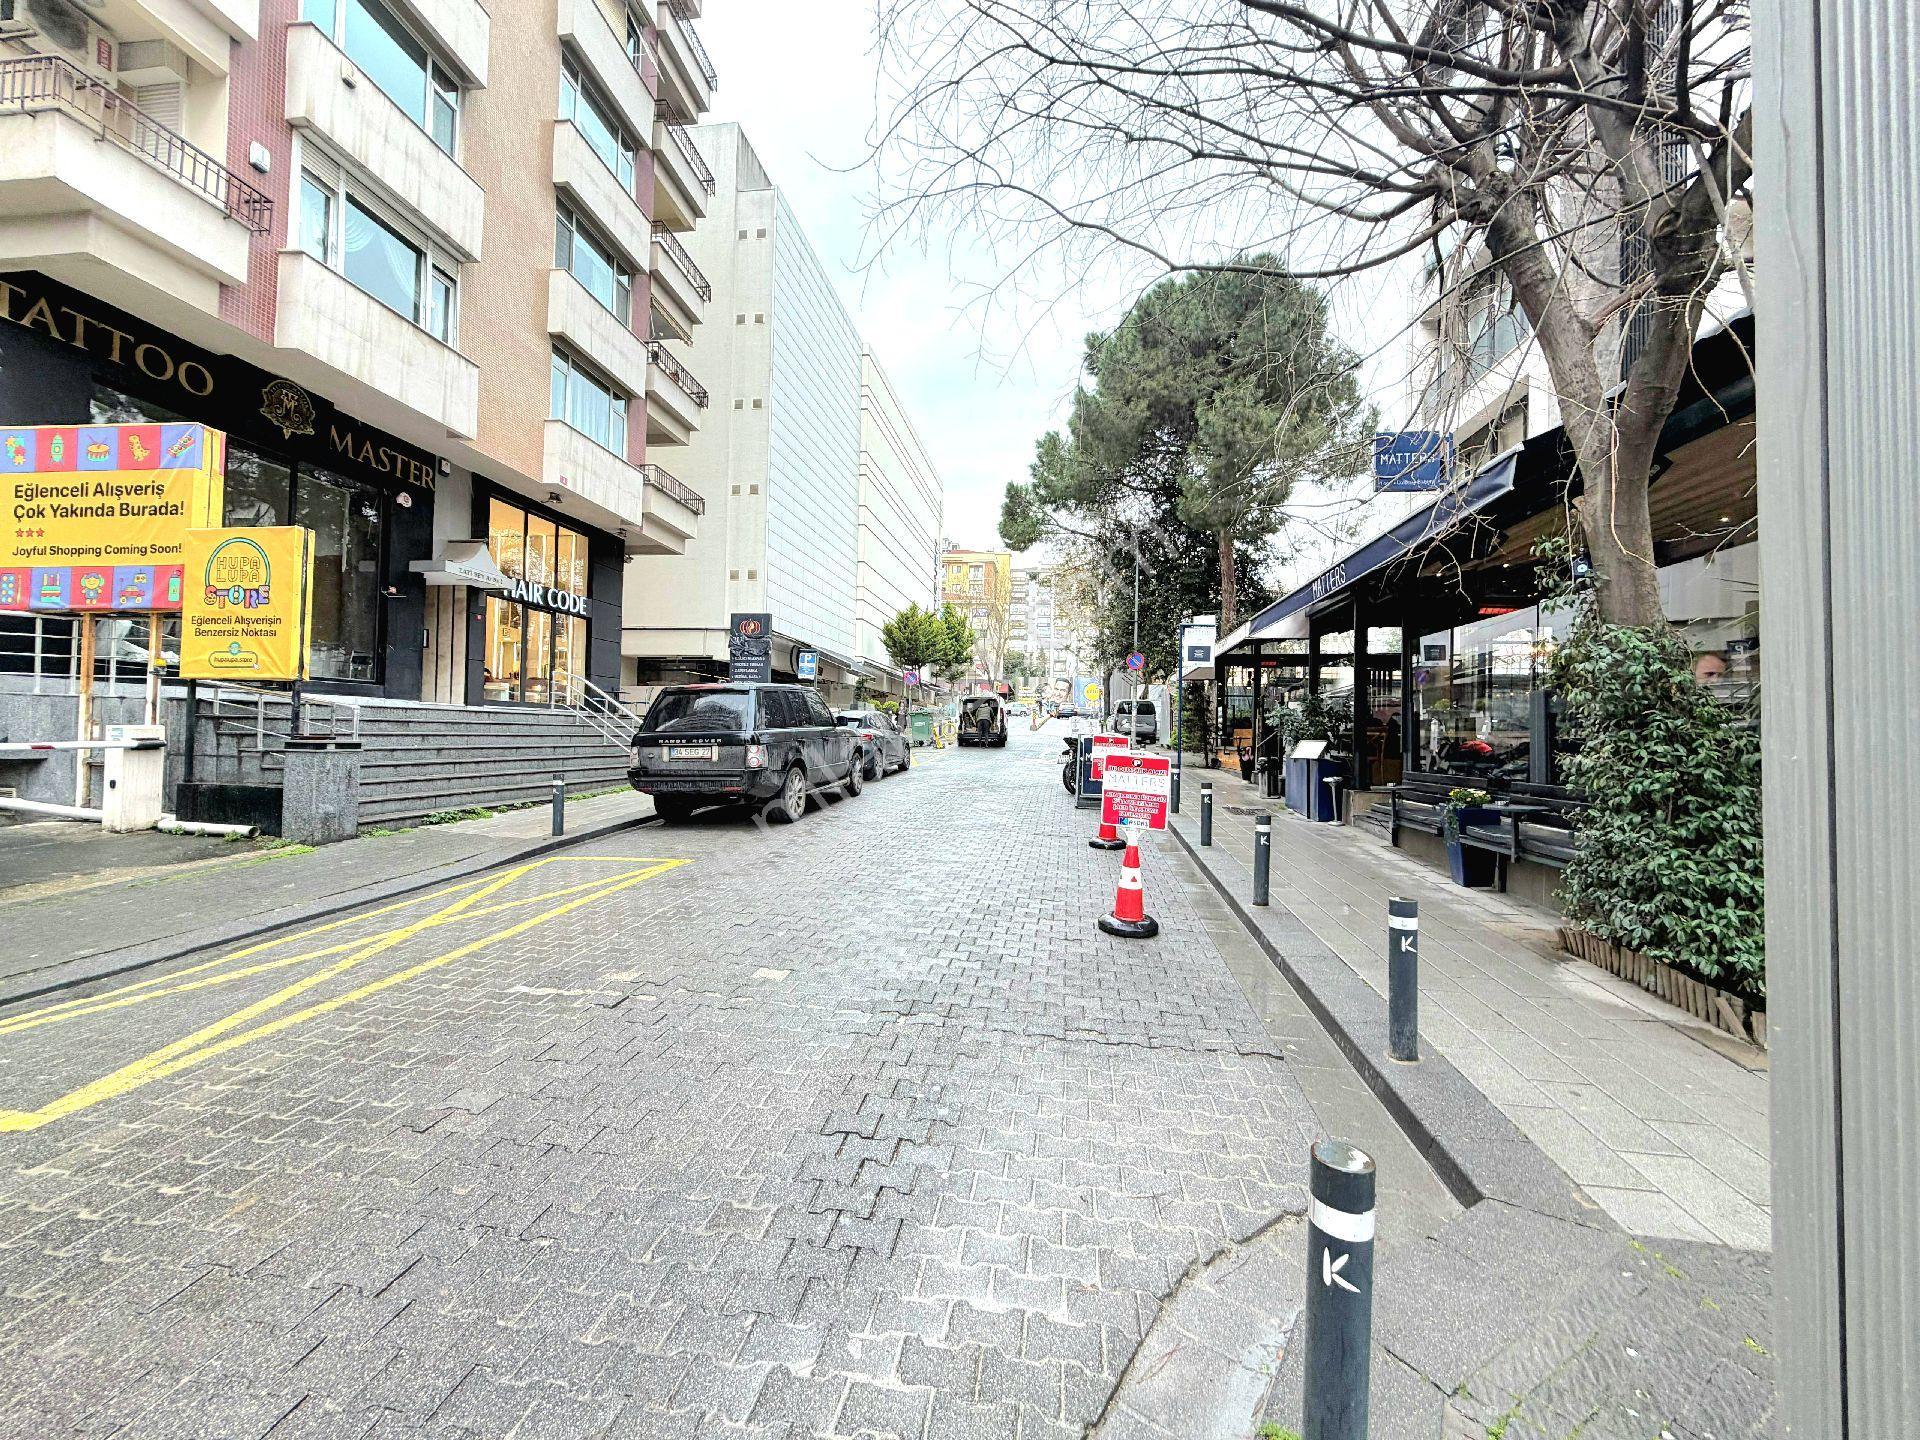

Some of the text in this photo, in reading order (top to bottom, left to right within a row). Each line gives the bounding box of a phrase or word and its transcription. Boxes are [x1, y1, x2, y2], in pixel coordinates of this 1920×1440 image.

[0, 281, 436, 491] TATTOO MASTER
[14, 480, 165, 501] Eğlenceli Alışveriş
[14, 501, 184, 523] Çok Yakında Burada!
[13, 543, 182, 558] Joyful Shopping Coming Soon!
[216, 556, 260, 570] HUPA
[216, 569, 260, 582] LUPA
[1312, 563, 1346, 600] MATTERS
[203, 585, 270, 609] STORE
[548, 588, 587, 615] CODE
[191, 614, 281, 627] Eğlenceli Alışverişin
[195, 627, 277, 637] Benzersiz Noktası
[1204, 796, 1211, 804] K
[1260, 835, 1269, 846] K
[1401, 935, 1417, 953] K
[1322, 1246, 1361, 1293] K
